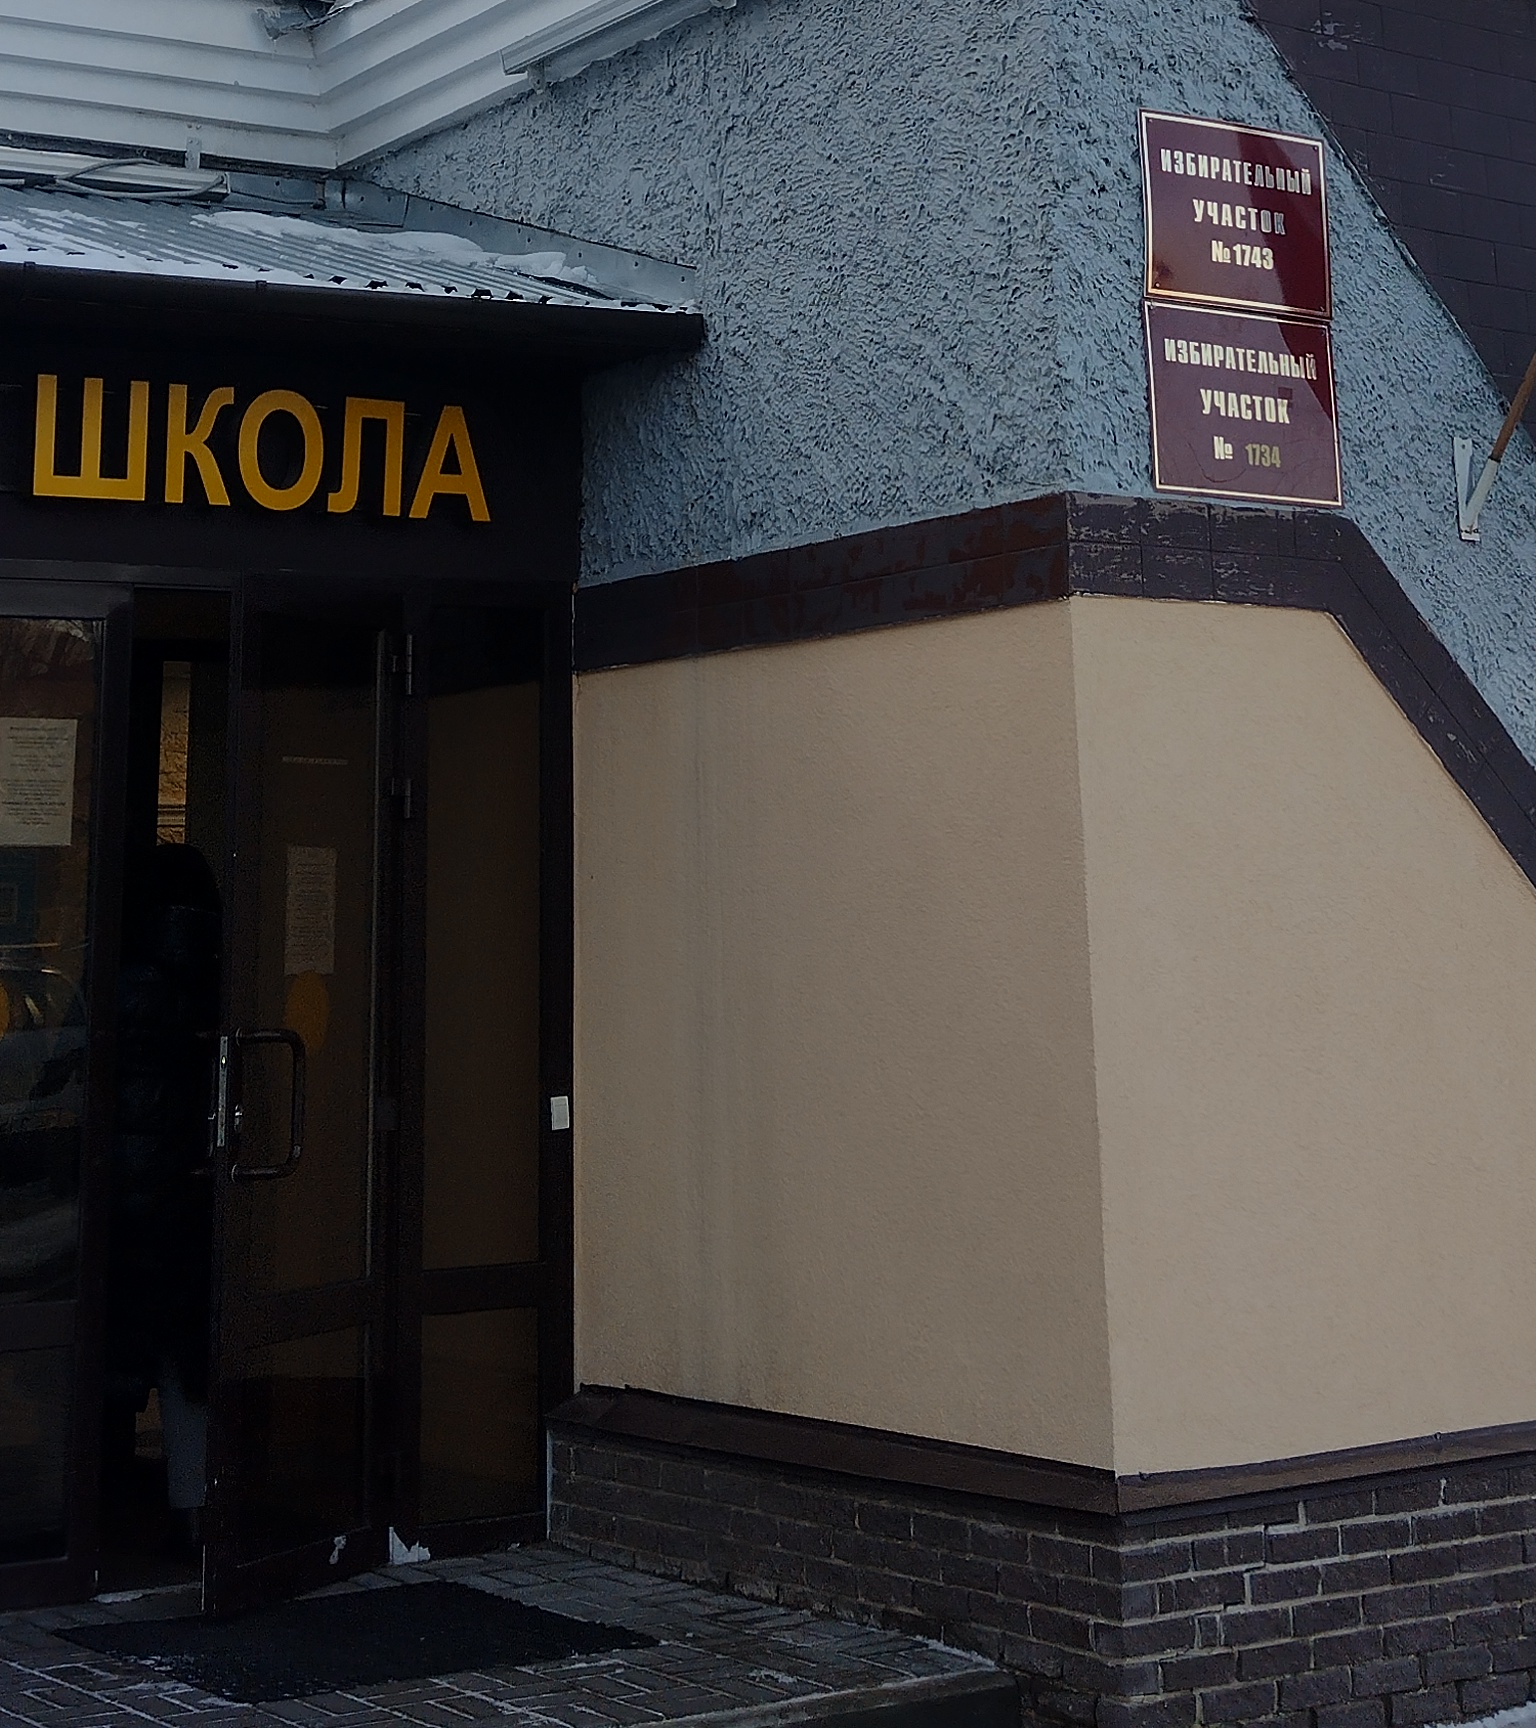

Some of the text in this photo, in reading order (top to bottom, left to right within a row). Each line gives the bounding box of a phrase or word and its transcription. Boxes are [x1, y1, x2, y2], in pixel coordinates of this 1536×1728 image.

[1160, 148, 1312, 196] ИЗБИРАТЕЛЬНЫЙ
[1192, 198, 1286, 235] УЧАСТОК
[1164, 338, 1317, 380] ИЗБИРАТЕЛЬНЫЙ
[1200, 388, 1290, 424] УЧАСТОК
[31, 372, 491, 523] ШКОЛА
[1213, 435, 1281, 468] № 1734
